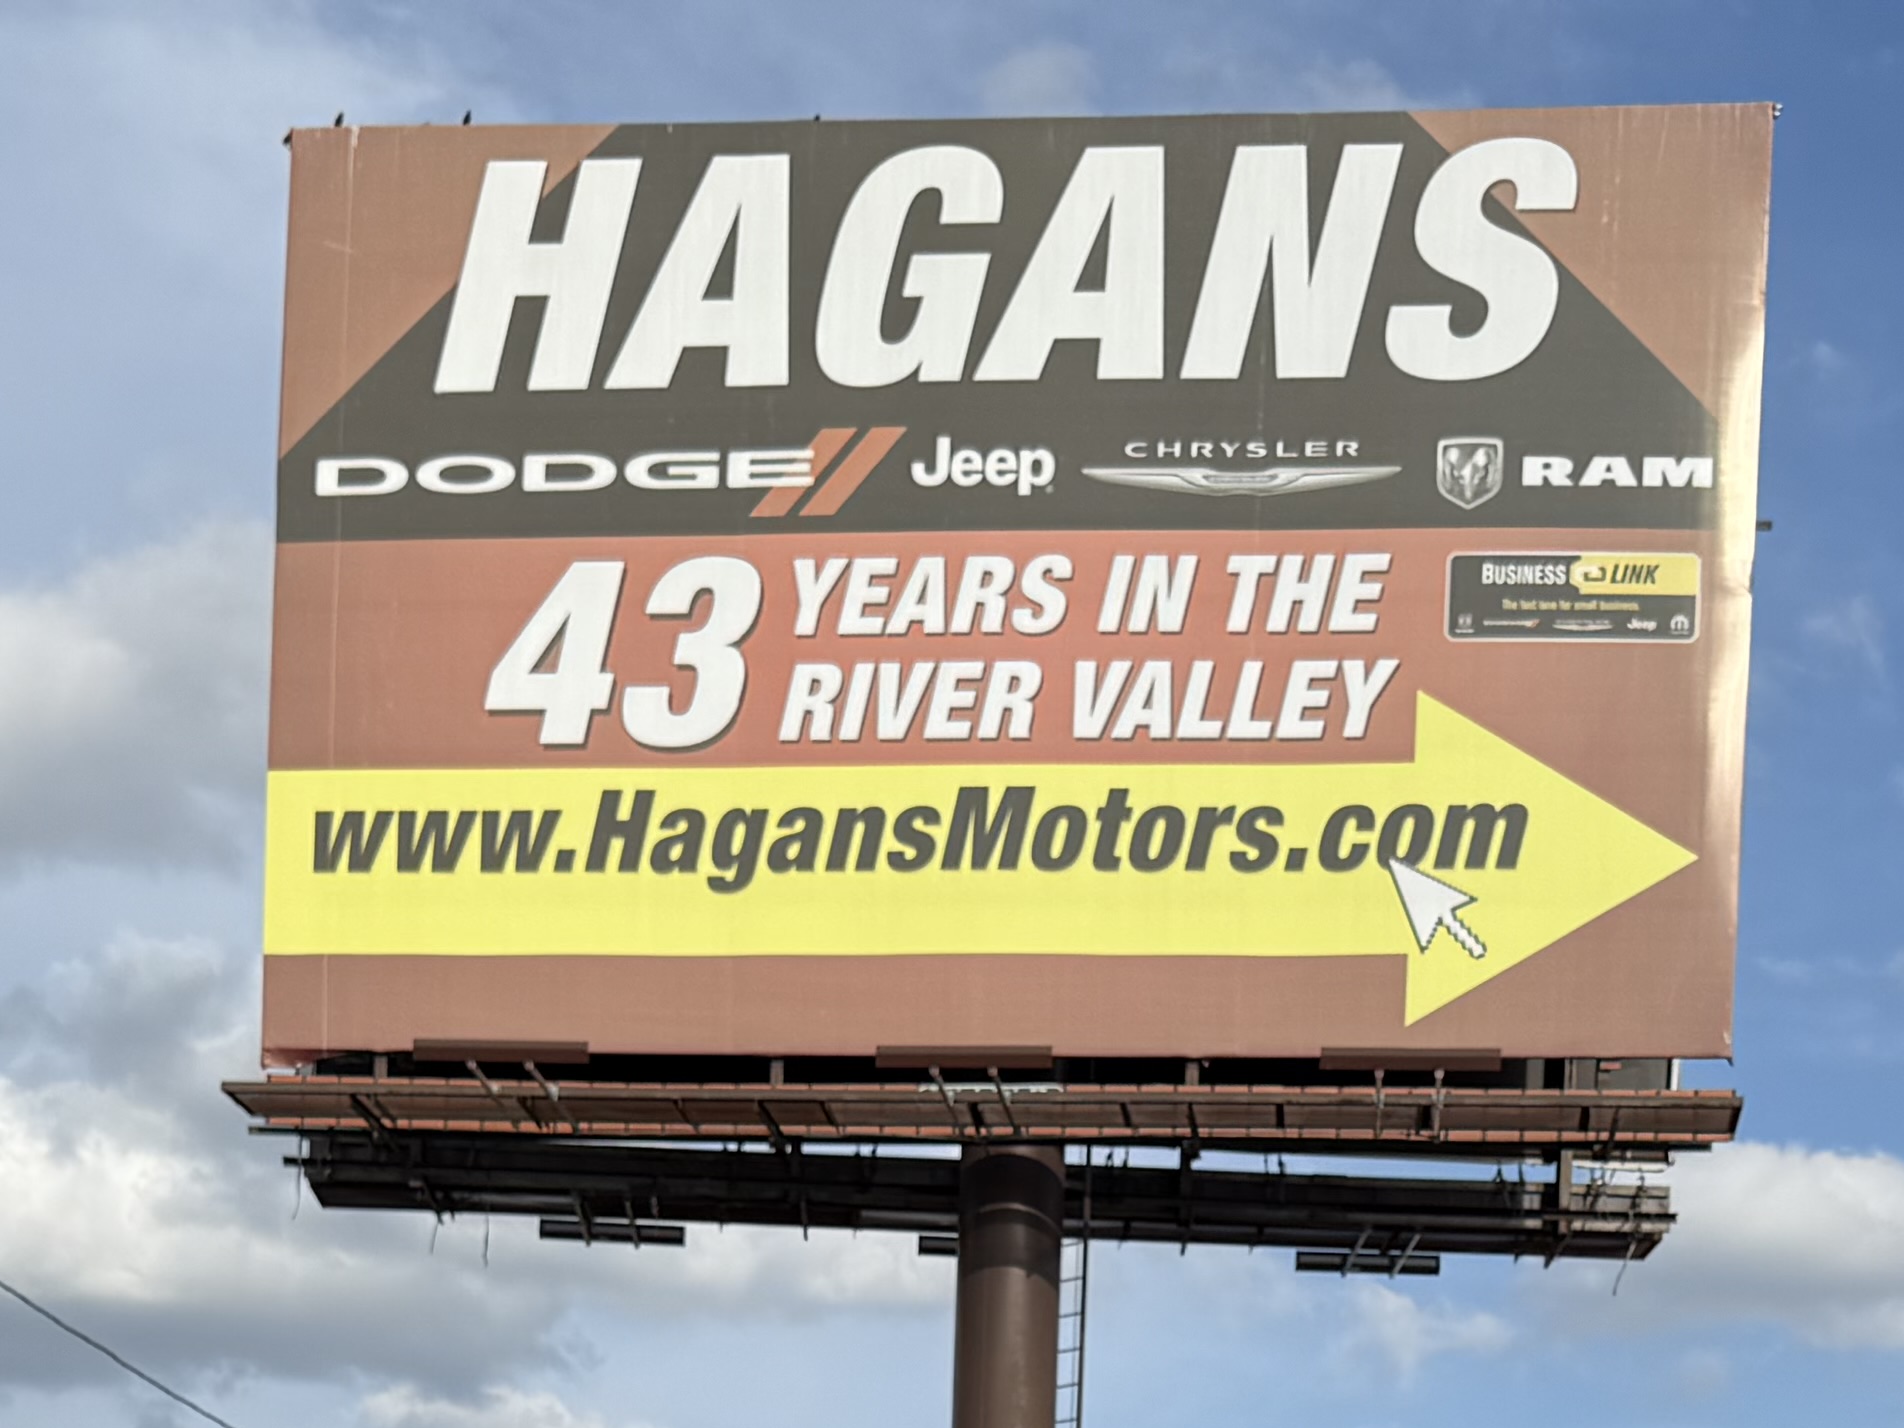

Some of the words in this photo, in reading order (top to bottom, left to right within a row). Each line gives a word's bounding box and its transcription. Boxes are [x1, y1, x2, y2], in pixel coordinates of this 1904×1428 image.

[433, 136, 1580, 393] HAGANS
[315, 449, 815, 496] DODGE
[909, 435, 1056, 496] Jeep
[1124, 440, 1360, 459] CHRYSLER
[1521, 455, 1713, 488] RAM
[791, 554, 1074, 637] YEARS
[1096, 553, 1199, 634] IN
[1225, 552, 1392, 634] THE
[1481, 563, 1567, 585] BUSINESS
[1609, 563, 1659, 585] LINK
[484, 555, 764, 752] 43
[1626, 617, 1658, 632] Jeep
[778, 658, 1043, 744] RIVER
[1071, 656, 1401, 742] VALLEY
[313, 785, 1529, 896] www.HagansMotors.com
